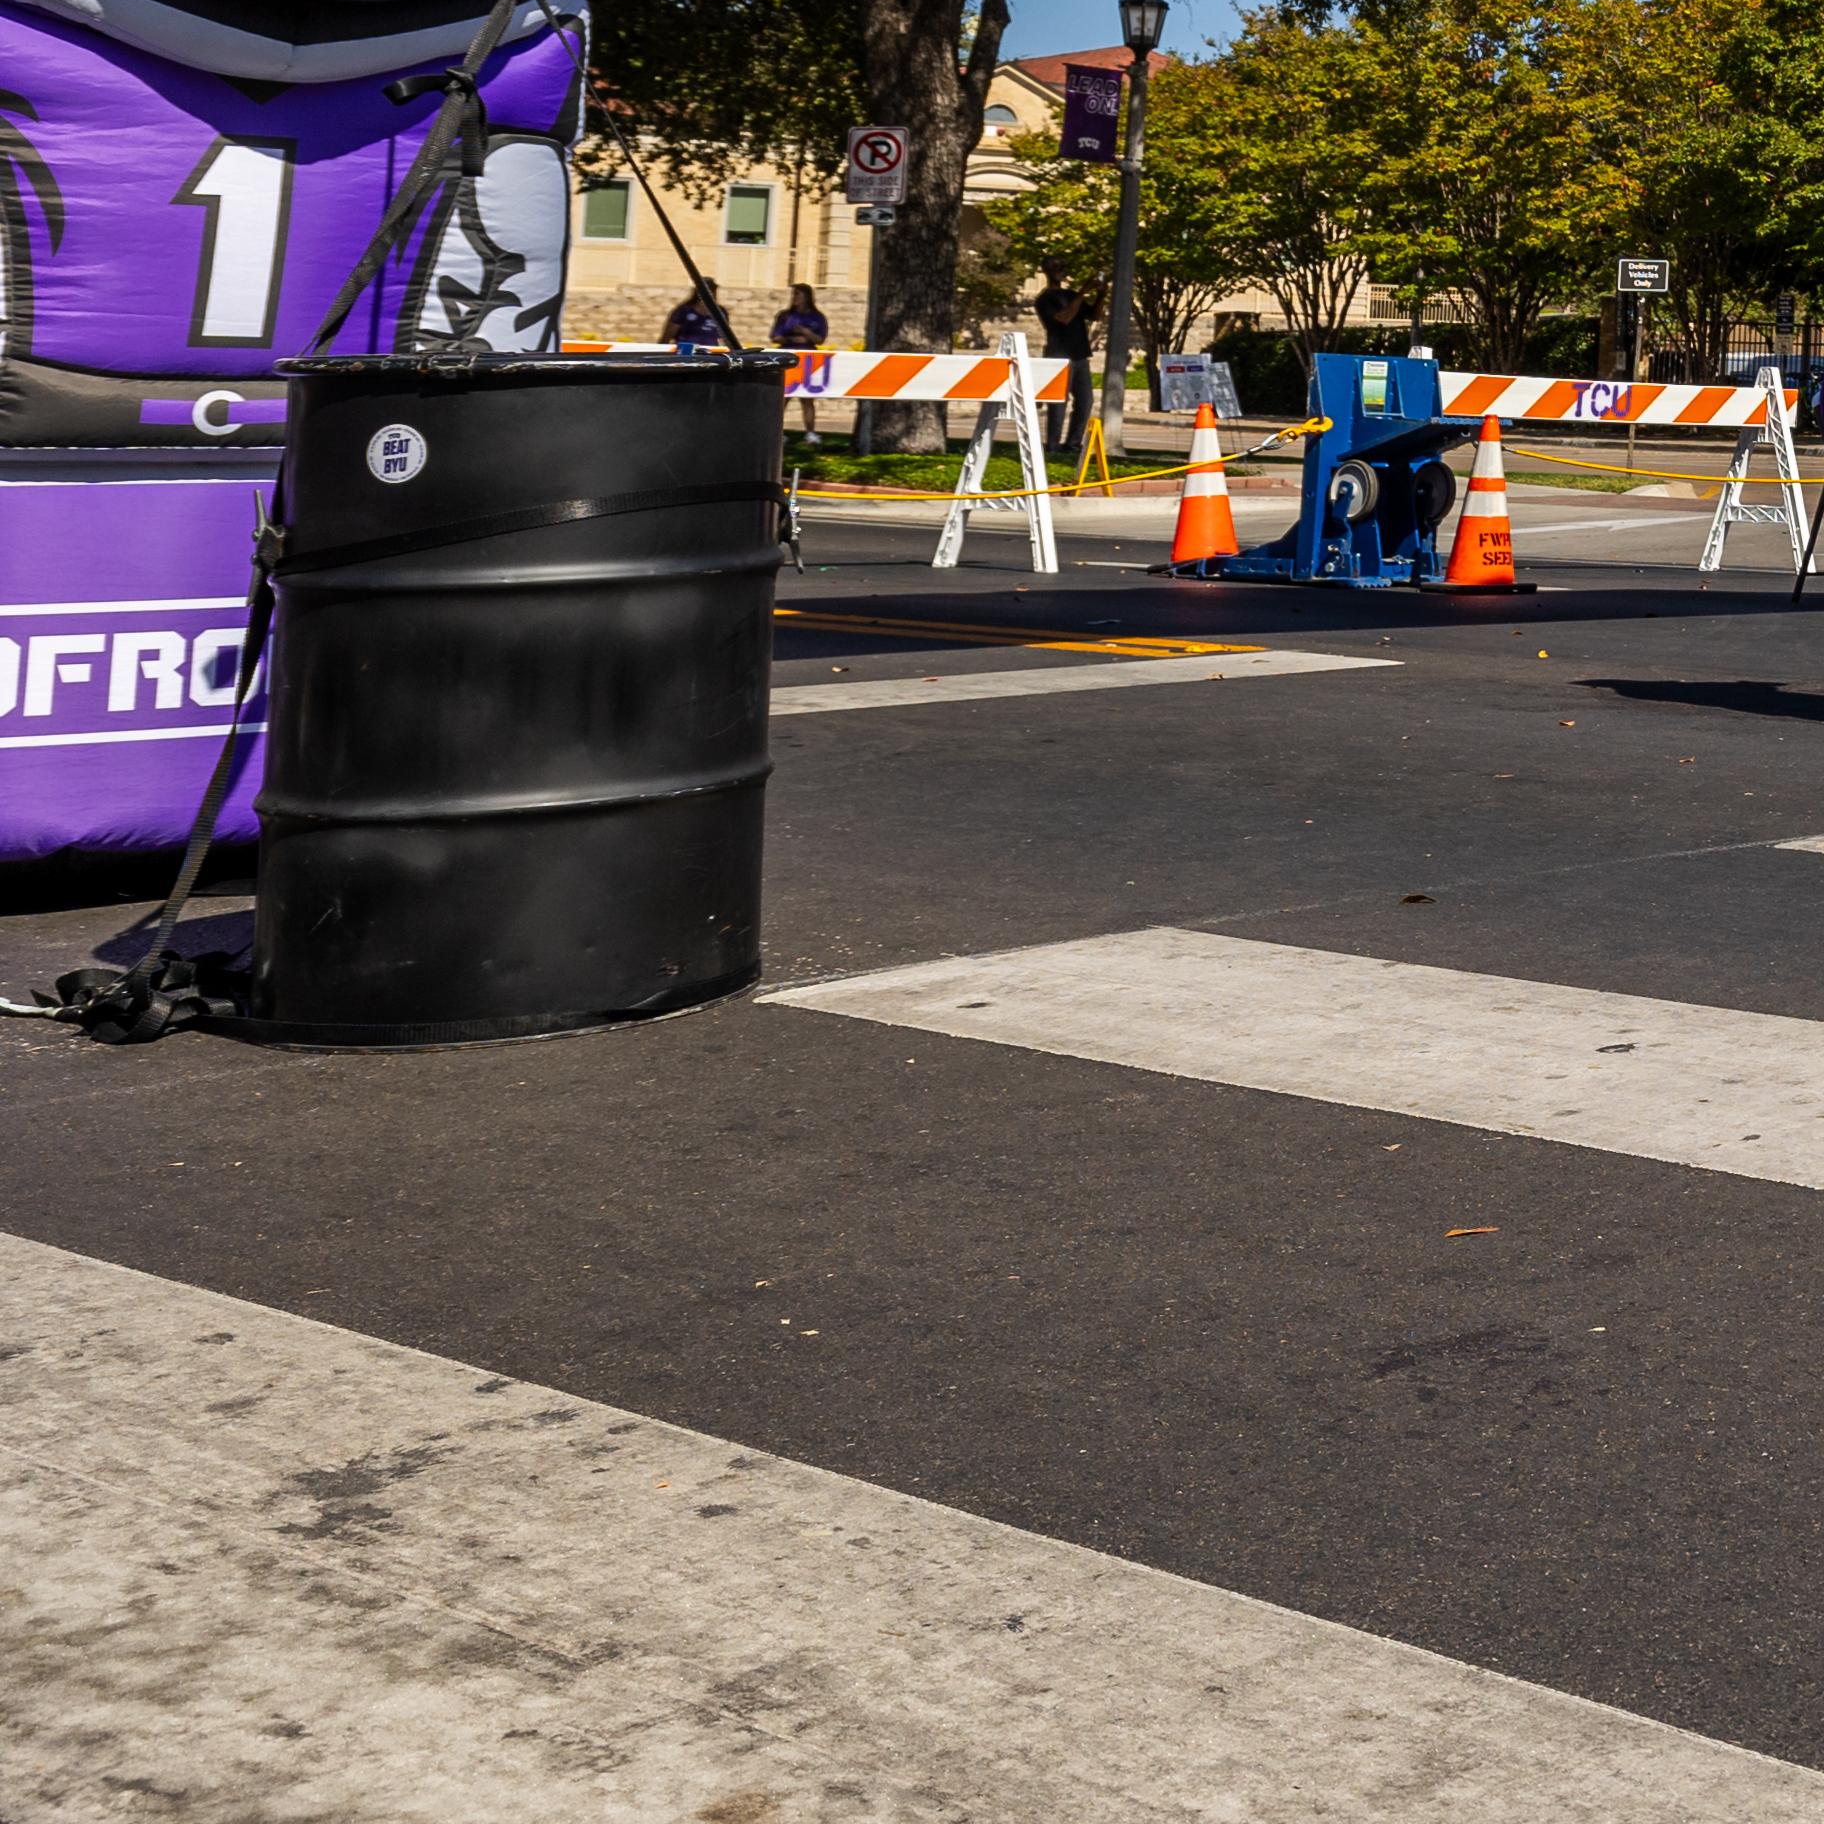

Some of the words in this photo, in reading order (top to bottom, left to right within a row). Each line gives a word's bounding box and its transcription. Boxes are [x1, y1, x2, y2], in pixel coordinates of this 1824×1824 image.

[1067, 74, 1119, 97] LEAD
[1078, 137, 1100, 150] TCU
[853, 176, 874, 185] THIS
[878, 176, 899, 185] SIDE
[180, 138, 293, 345] 1
[1628, 262, 1659, 272] Delivery
[1628, 271, 1659, 279] Vehicles
[1633, 279, 1652, 288] Only
[1572, 383, 1632, 418] TCU
[383, 438, 411, 456] BEAT
[384, 457, 407, 474] BYU
